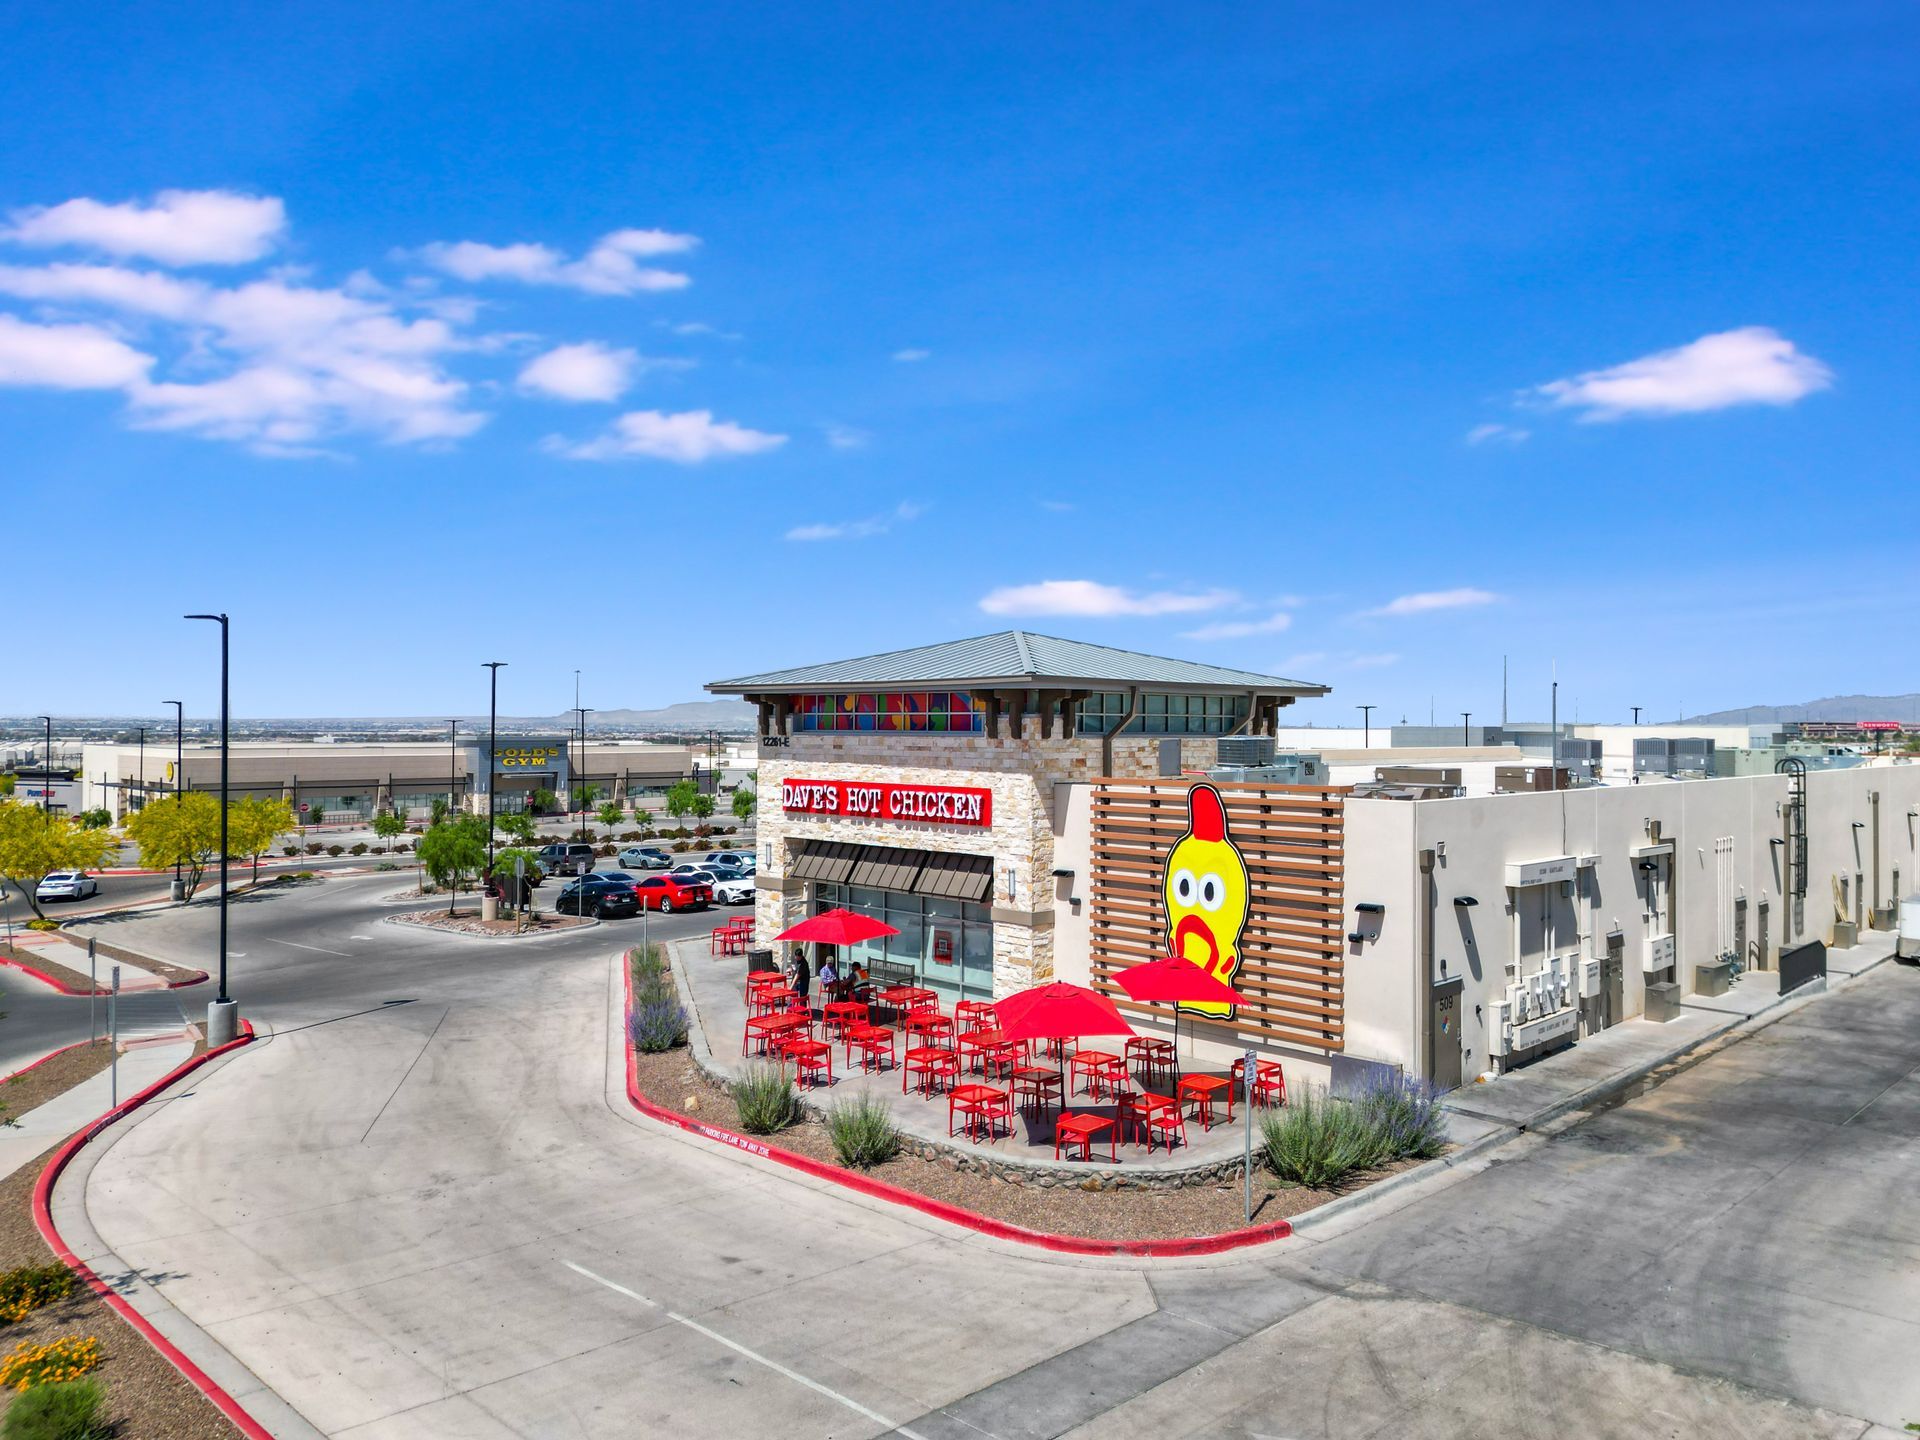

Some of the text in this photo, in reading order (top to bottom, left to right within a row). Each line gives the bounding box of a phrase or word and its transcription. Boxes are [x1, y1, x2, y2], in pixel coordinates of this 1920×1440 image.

[763, 737, 790, 748] 12261-E
[502, 757, 546, 767] GYM
[783, 784, 981, 820] DAVE'S HOT CHICKEN
[1439, 996, 1453, 1012] 509
[720, 1132, 729, 1142] FIRE
[729, 1135, 739, 1145] LANE
[758, 1146, 769, 1157] ZONE
